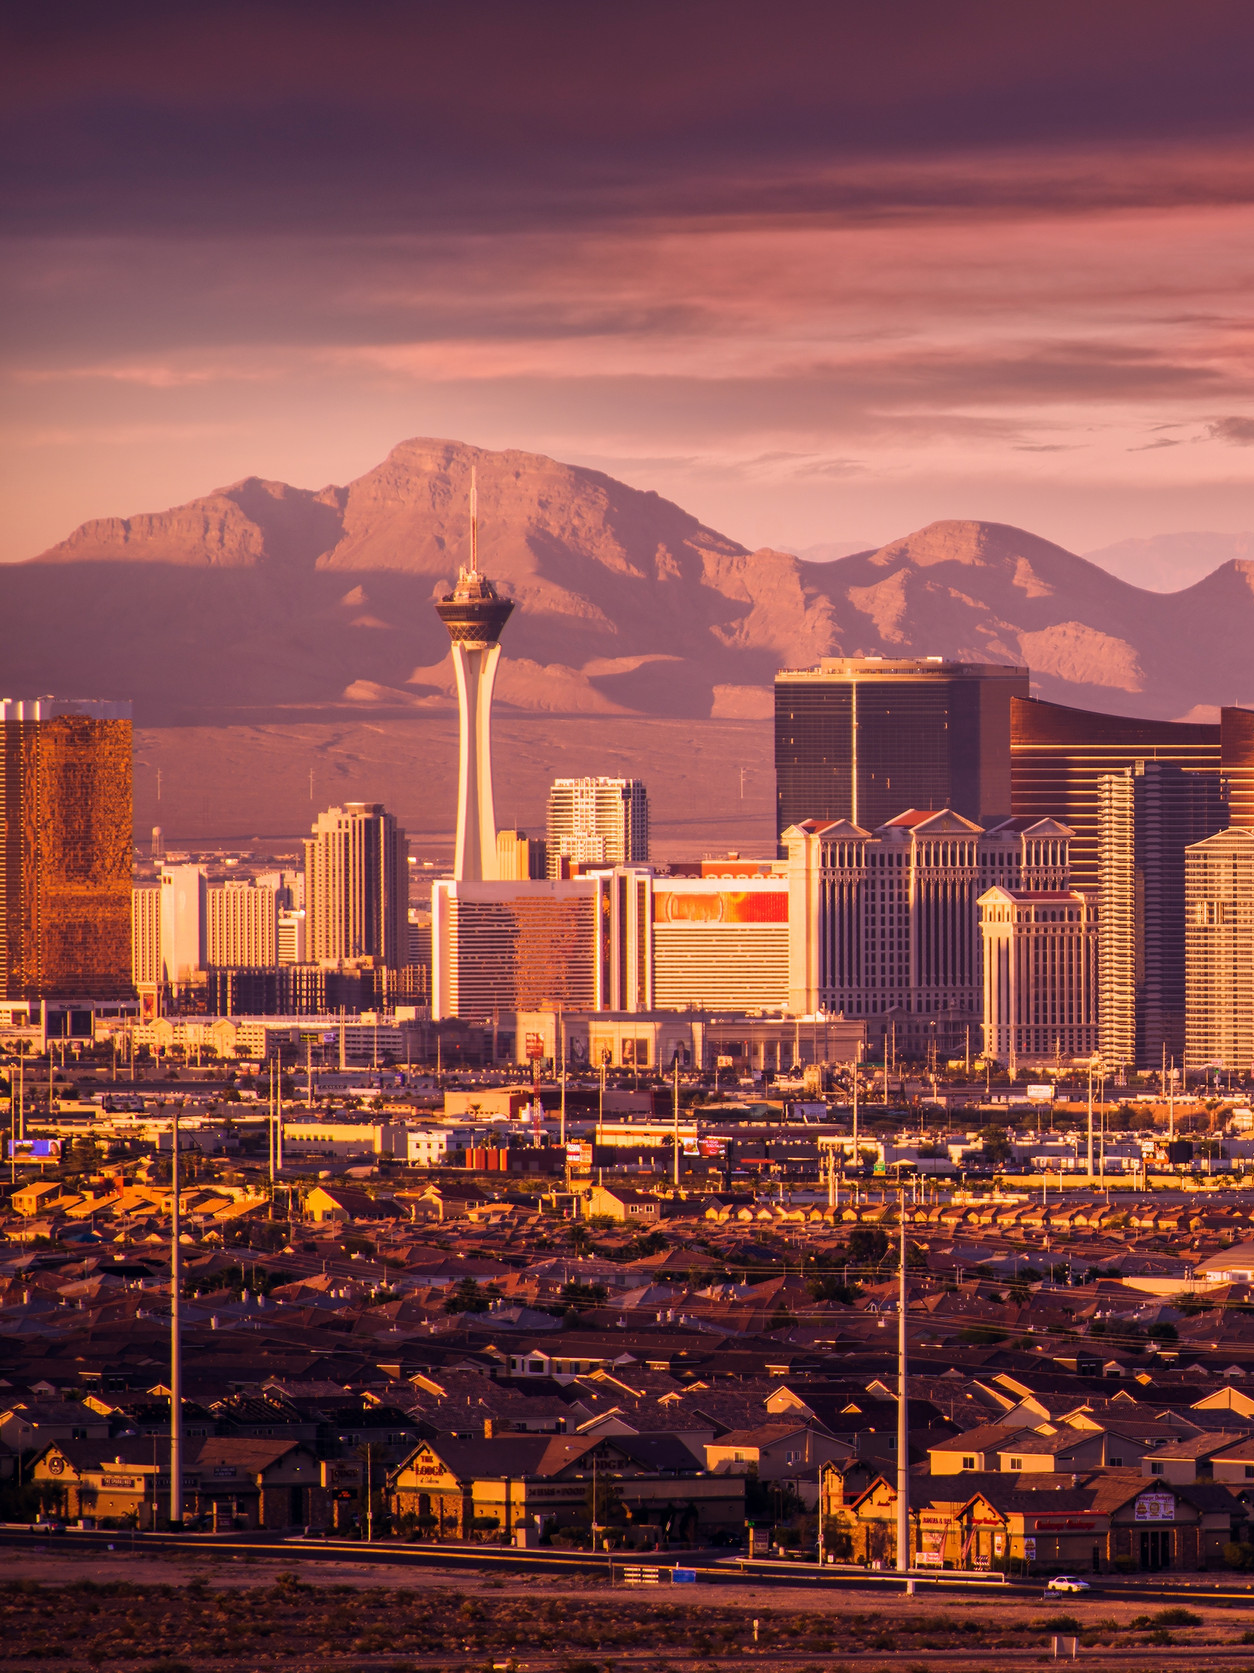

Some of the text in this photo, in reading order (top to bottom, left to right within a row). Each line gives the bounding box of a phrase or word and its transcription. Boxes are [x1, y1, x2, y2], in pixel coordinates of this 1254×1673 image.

[420, 1455, 434, 1463] THE
[582, 1459, 625, 1471] LODGE
[415, 1463, 444, 1476] LODGE
